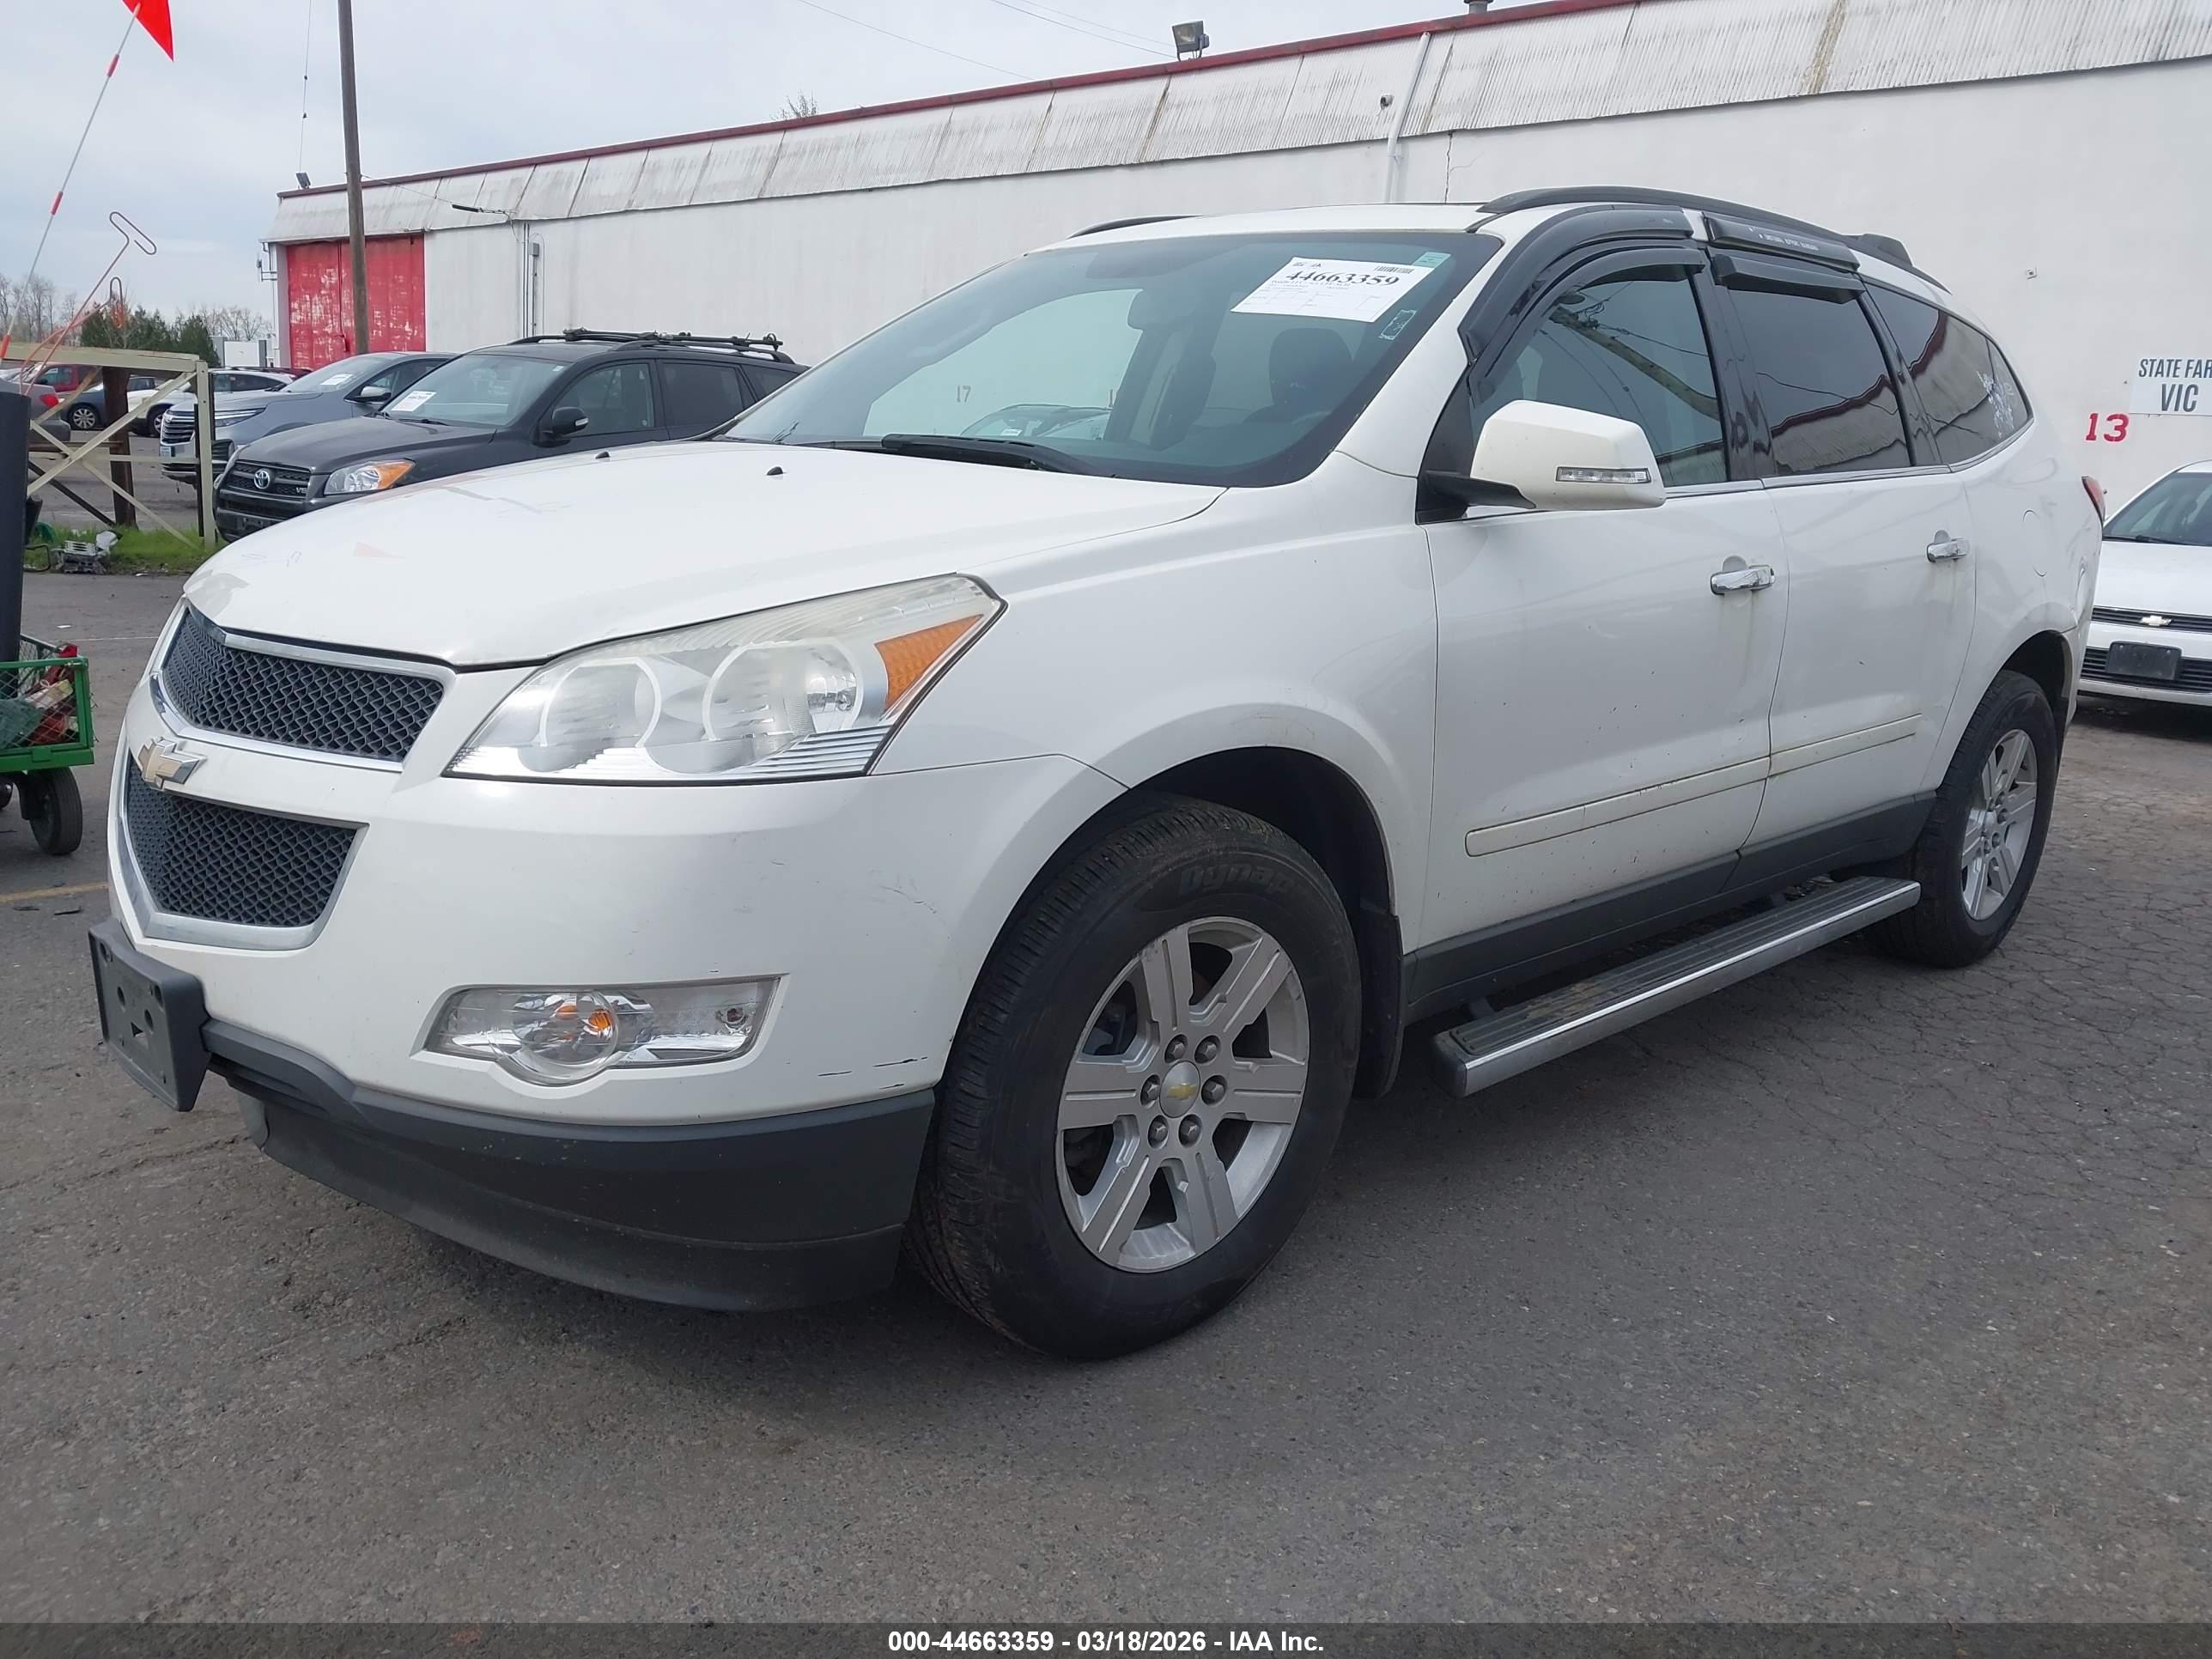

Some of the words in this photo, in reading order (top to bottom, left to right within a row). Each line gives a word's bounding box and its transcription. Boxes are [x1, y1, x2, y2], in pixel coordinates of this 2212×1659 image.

[1285, 270, 1401, 286] 44663359
[2138, 358, 2182, 378] STATE
[2185, 359, 2212, 379] FAR
[956, 385, 971, 403] 17
[2160, 383, 2198, 412] VIC
[2085, 412, 2130, 442] 13
[1179, 863, 1300, 899] Dynap
